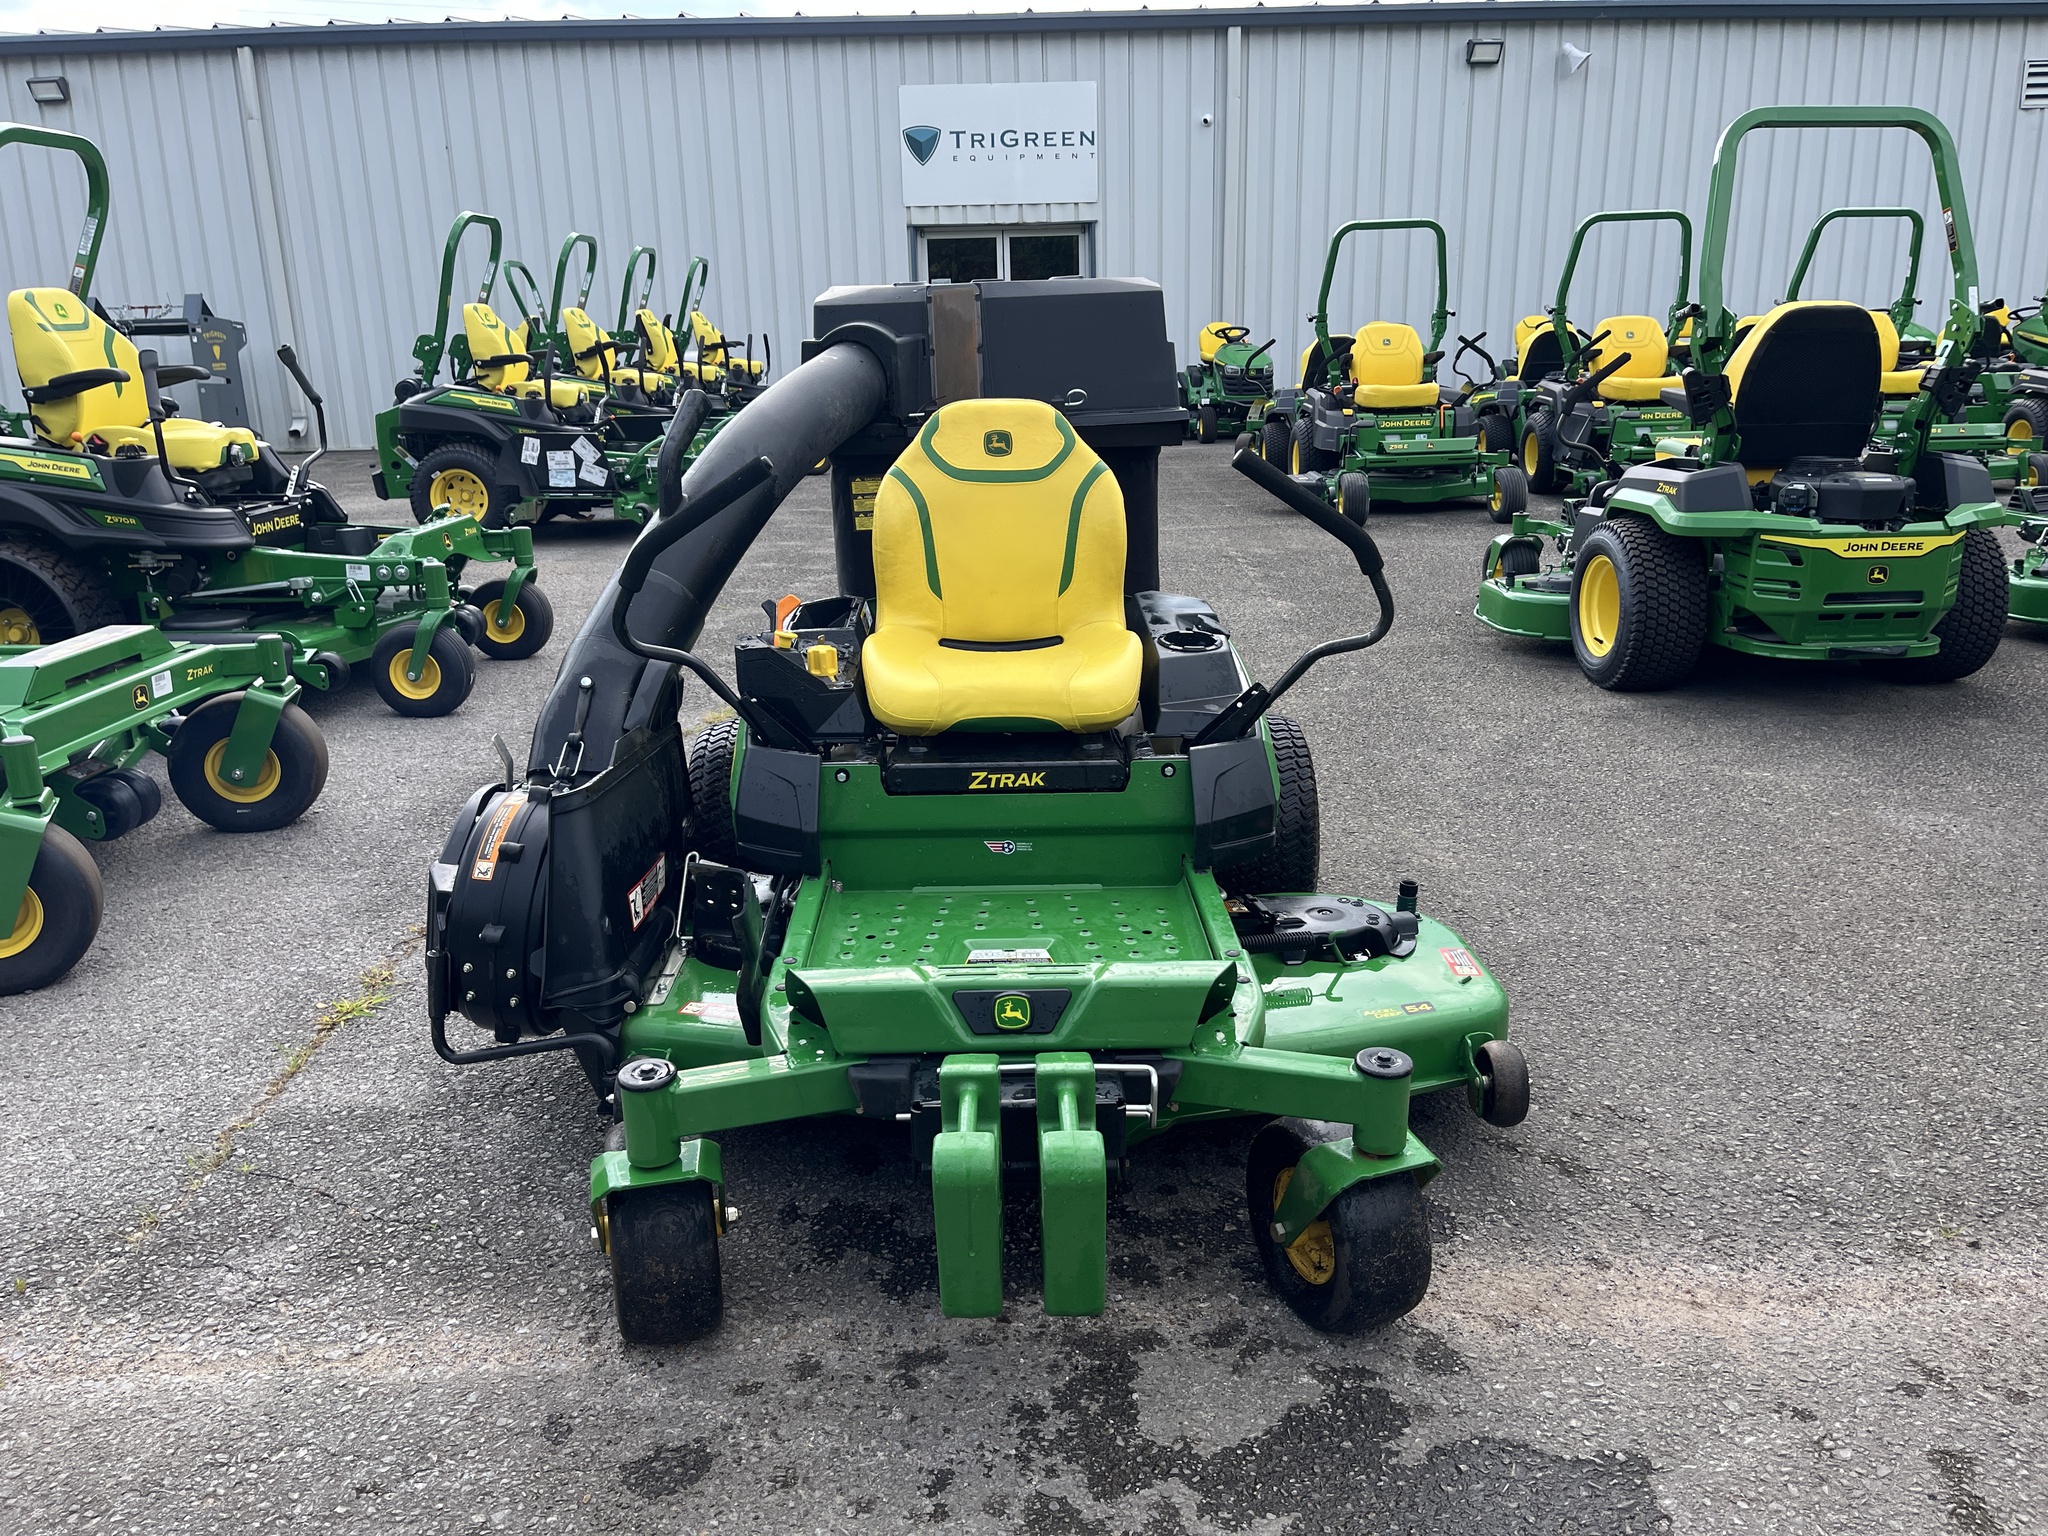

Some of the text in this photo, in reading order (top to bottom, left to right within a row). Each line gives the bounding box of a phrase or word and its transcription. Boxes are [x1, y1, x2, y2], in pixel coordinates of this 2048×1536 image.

[949, 129, 1095, 149] TRIGREEN
[952, 152, 1096, 162] EQUIPMENT
[1404, 419, 1431, 427] DEERE
[26, 460, 81, 474] JOHN DEERE
[1656, 482, 1678, 495] ZTRAK
[104, 514, 137, 525] Z970R
[252, 513, 300, 537] JOHN DEERE
[1843, 541, 1925, 553] JOHN DEERE
[186, 664, 214, 682] ZTRAK
[968, 771, 1047, 790] ZTRAK
[1404, 1003, 1432, 1013] 54
